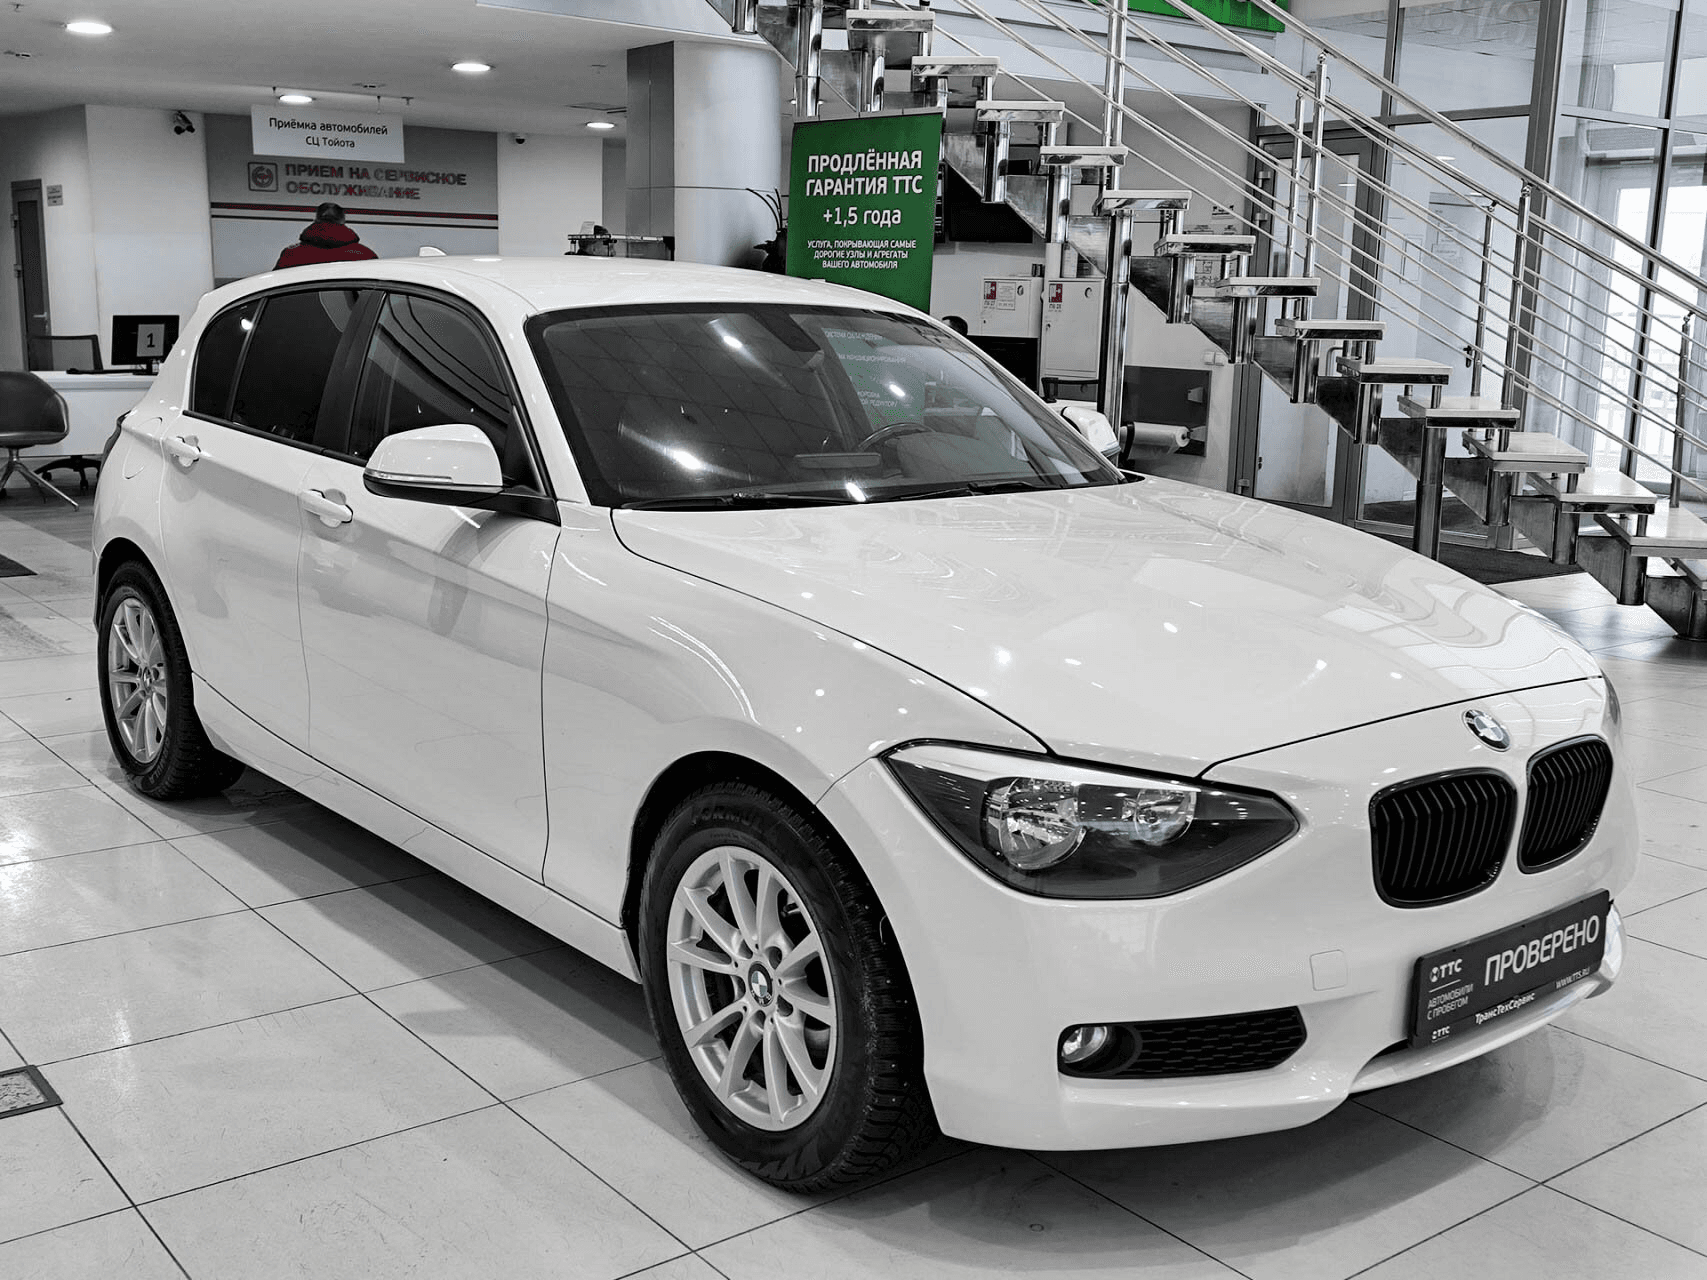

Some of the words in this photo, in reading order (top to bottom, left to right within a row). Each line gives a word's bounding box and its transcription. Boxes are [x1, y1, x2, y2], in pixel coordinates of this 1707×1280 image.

[269, 117, 317, 131] Приёмка
[320, 122, 388, 135] автомобилей
[305, 136, 320, 147] СЦ
[323, 137, 355, 148] Тойота
[807, 148, 923, 175] ПРОДЛЁННАЯ
[285, 163, 344, 179] ПРИЕМ
[349, 166, 370, 180] НА
[374, 168, 467, 186] СЕРВИСНОЕ
[286, 181, 421, 200] ОБСЛУЖИВАНИЕ
[806, 177, 888, 196] ГАРАНТИЯ
[893, 175, 923, 194] ТТС
[823, 207, 858, 228] +1,5
[863, 209, 902, 228] года
[807, 239, 833, 249] УСЛУГА,
[834, 239, 889, 249] ПОКРЫВАЮЩАЯ
[890, 239, 917, 249] САМЫЕ
[813, 250, 845, 259] ДОРОГИЕ
[846, 250, 866, 259] УЗЛЫ
[867, 250, 873, 259] И
[873, 250, 909, 259] АГРЕГАТЫ
[822, 260, 850, 269] ВАШЕГО
[850, 260, 898, 269] АВТОМОБИЛЯ
[147, 332, 155, 348] 1
[1484, 915, 1600, 986] ПРОВЕРЕНО
[1440, 958, 1463, 978] ТТС
[1428, 983, 1474, 1009] АВТОМОБИЛИ
[1427, 1010, 1433, 1020] С
[1432, 996, 1469, 1018] ПРОБЕГОМ
[1475, 992, 1536, 1025] ТрансТехСервис
